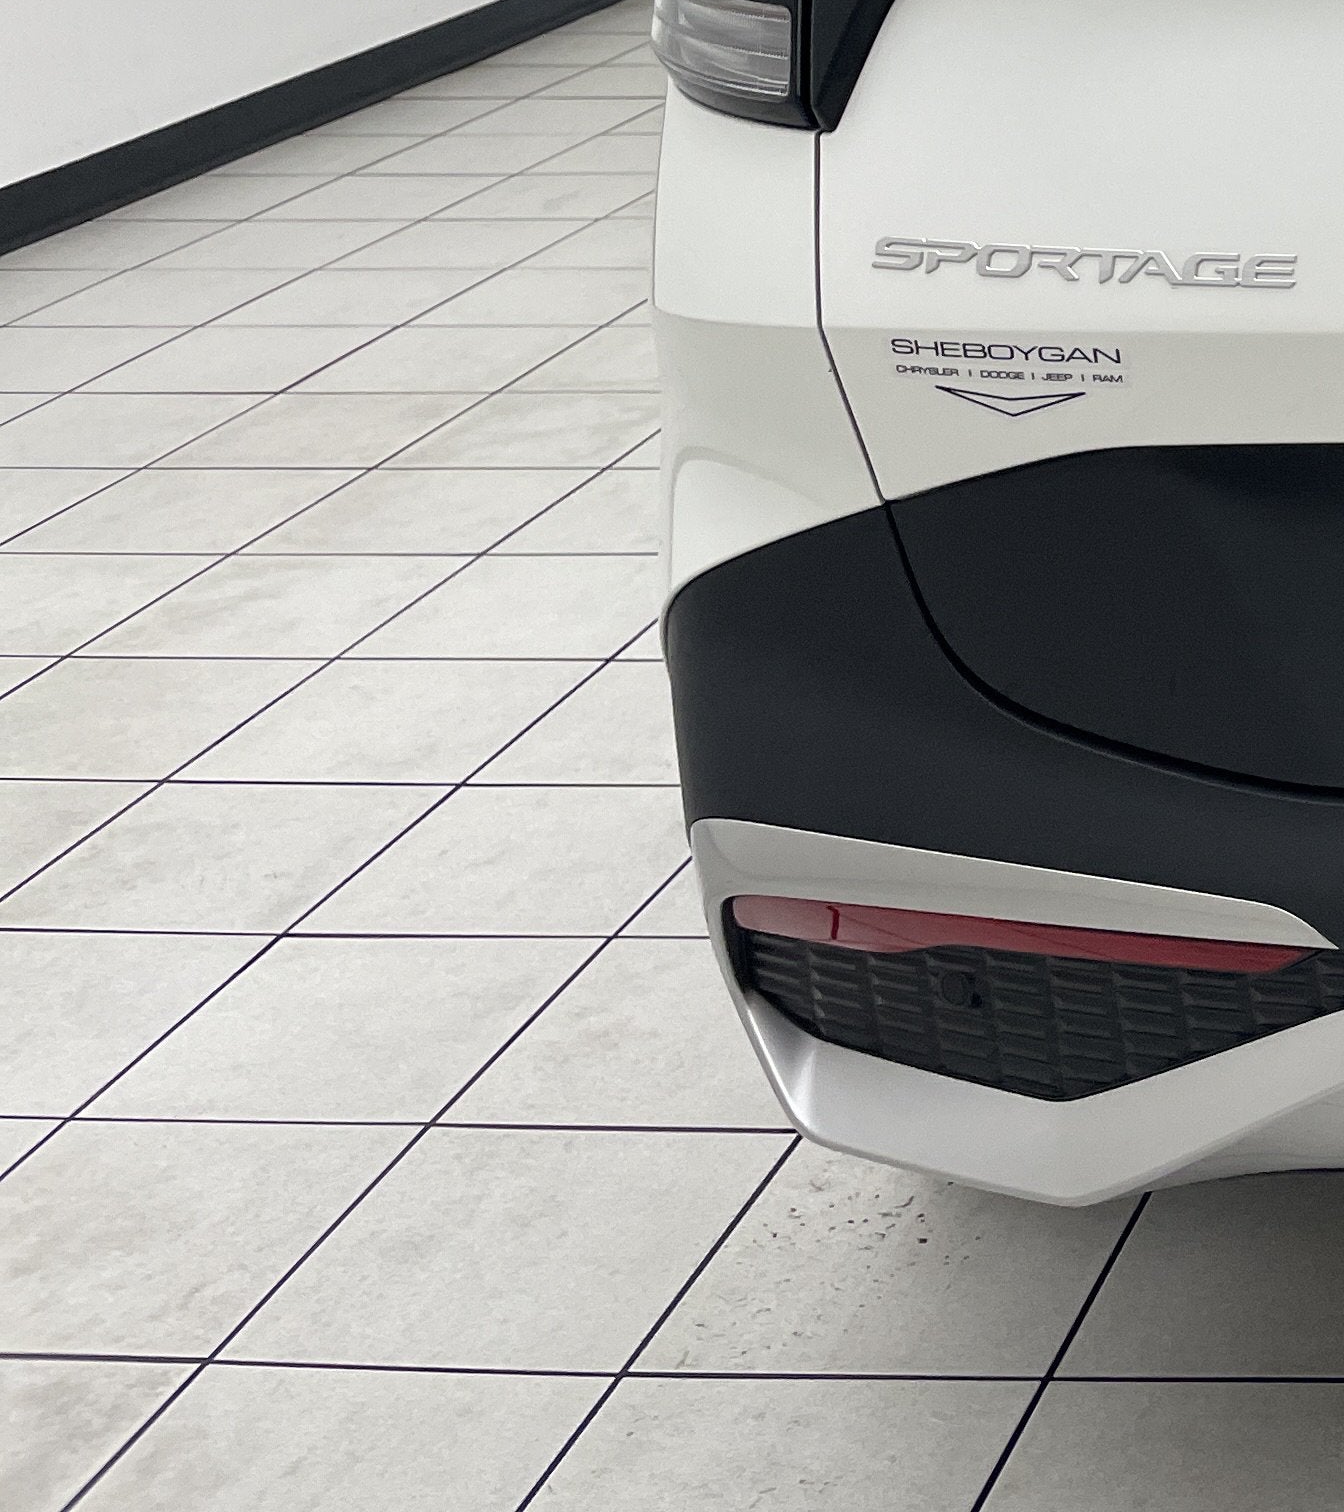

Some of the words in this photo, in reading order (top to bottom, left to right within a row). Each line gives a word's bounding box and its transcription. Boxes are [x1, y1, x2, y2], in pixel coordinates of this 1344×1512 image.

[871, 235, 1298, 289] SPORTAGE
[891, 338, 1121, 364] SHEBOYGAN
[895, 364, 960, 377] CHRYSLER
[979, 369, 1025, 380] DODGE
[1041, 373, 1074, 382] JEEP
[1092, 374, 1124, 383] RAM
